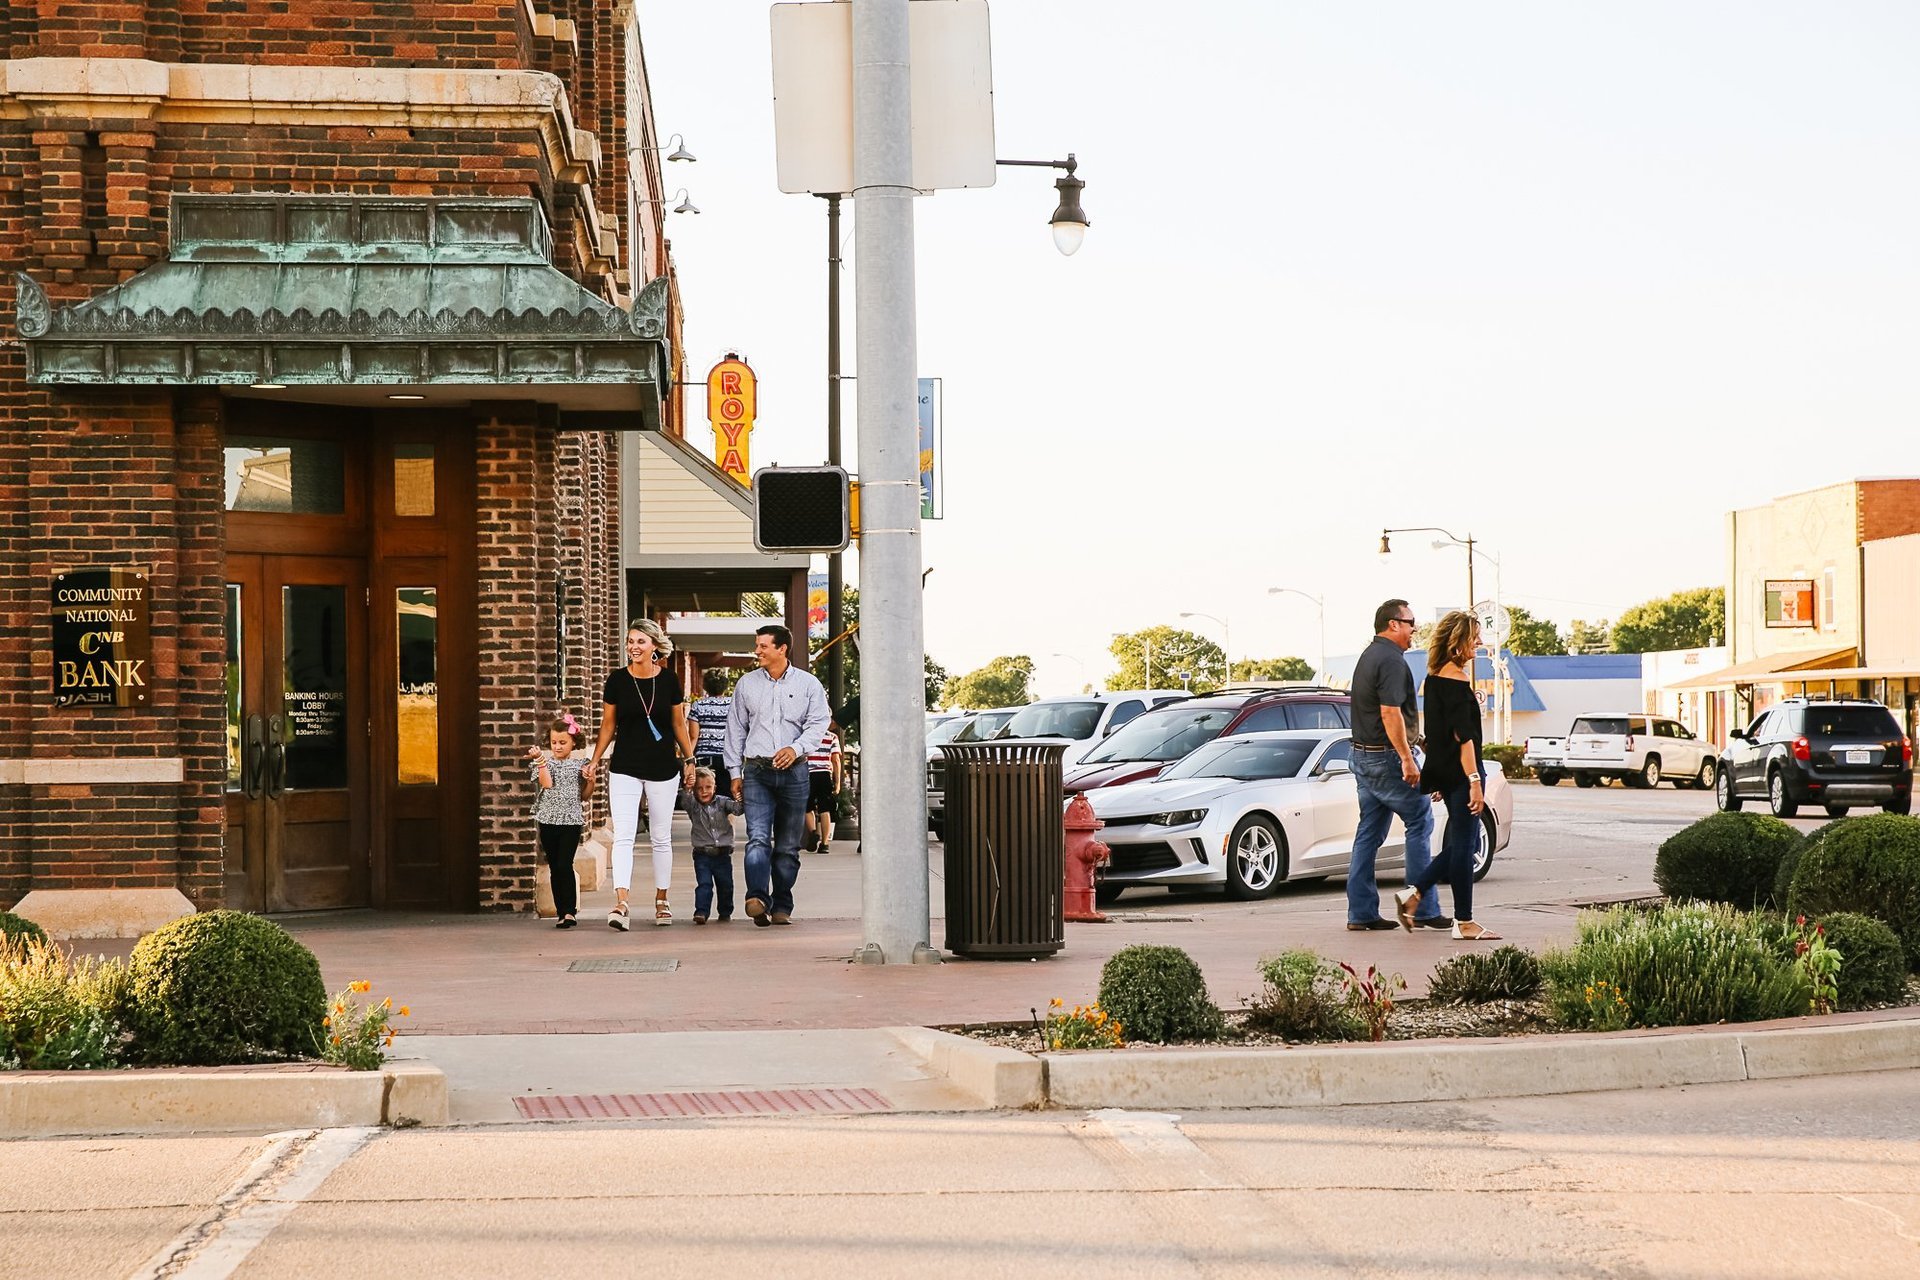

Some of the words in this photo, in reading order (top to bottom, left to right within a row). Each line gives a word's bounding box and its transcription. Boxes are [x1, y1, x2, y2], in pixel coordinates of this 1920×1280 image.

[720, 371, 746, 474] ROYA
[58, 588, 143, 602] COMMUNITY
[65, 609, 137, 623] NATIONAL
[58, 660, 146, 688] BANK
[285, 692, 317, 700] BANKING
[318, 692, 344, 700] HOURS
[302, 701, 327, 710] LOBBY
